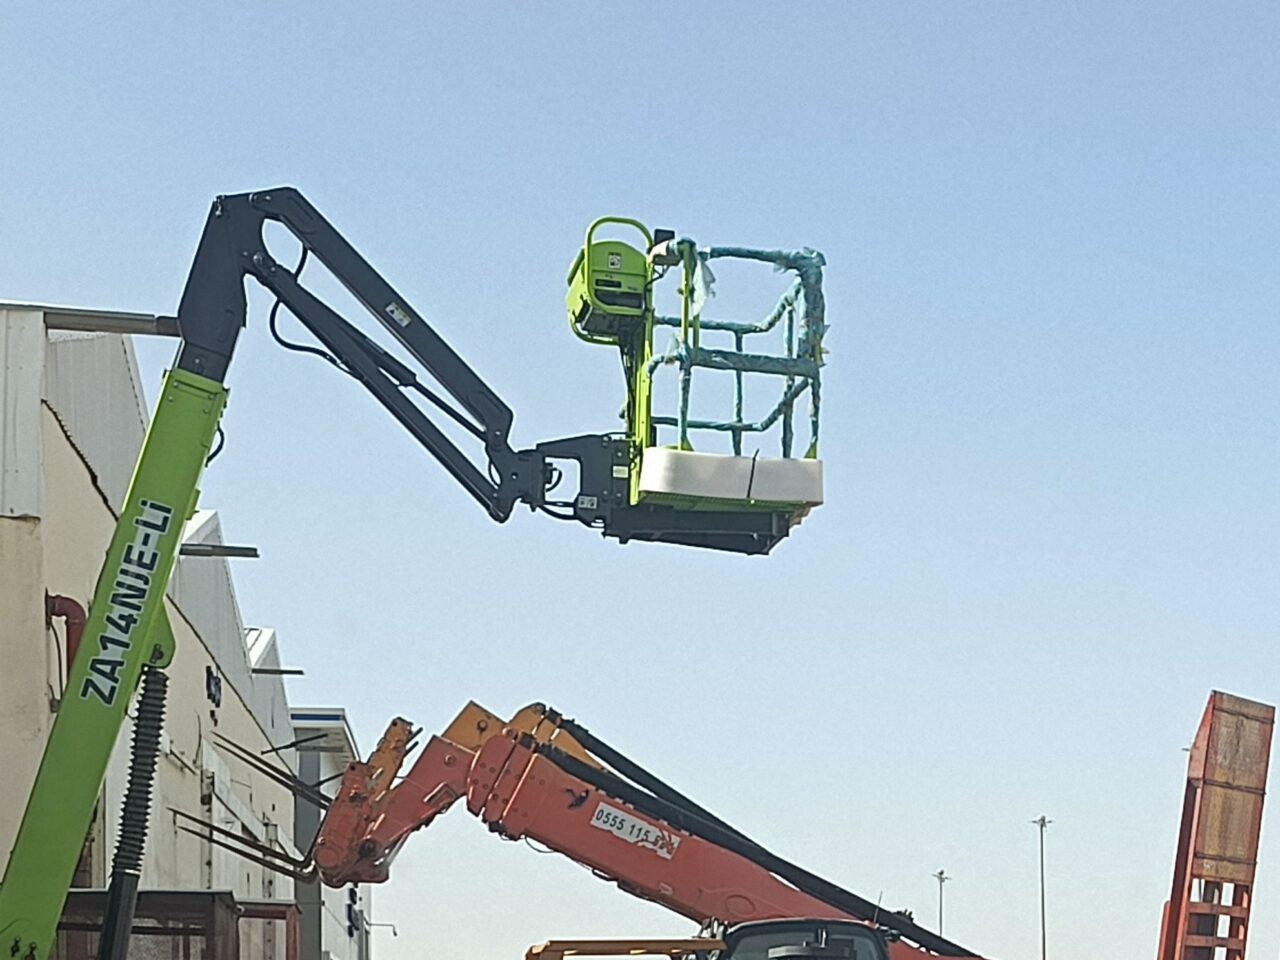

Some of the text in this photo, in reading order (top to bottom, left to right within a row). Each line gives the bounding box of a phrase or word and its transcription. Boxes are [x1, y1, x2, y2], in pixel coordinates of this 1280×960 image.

[81, 499, 173, 705] ZA14NJE-Li
[596, 809, 651, 841] 0555 115
